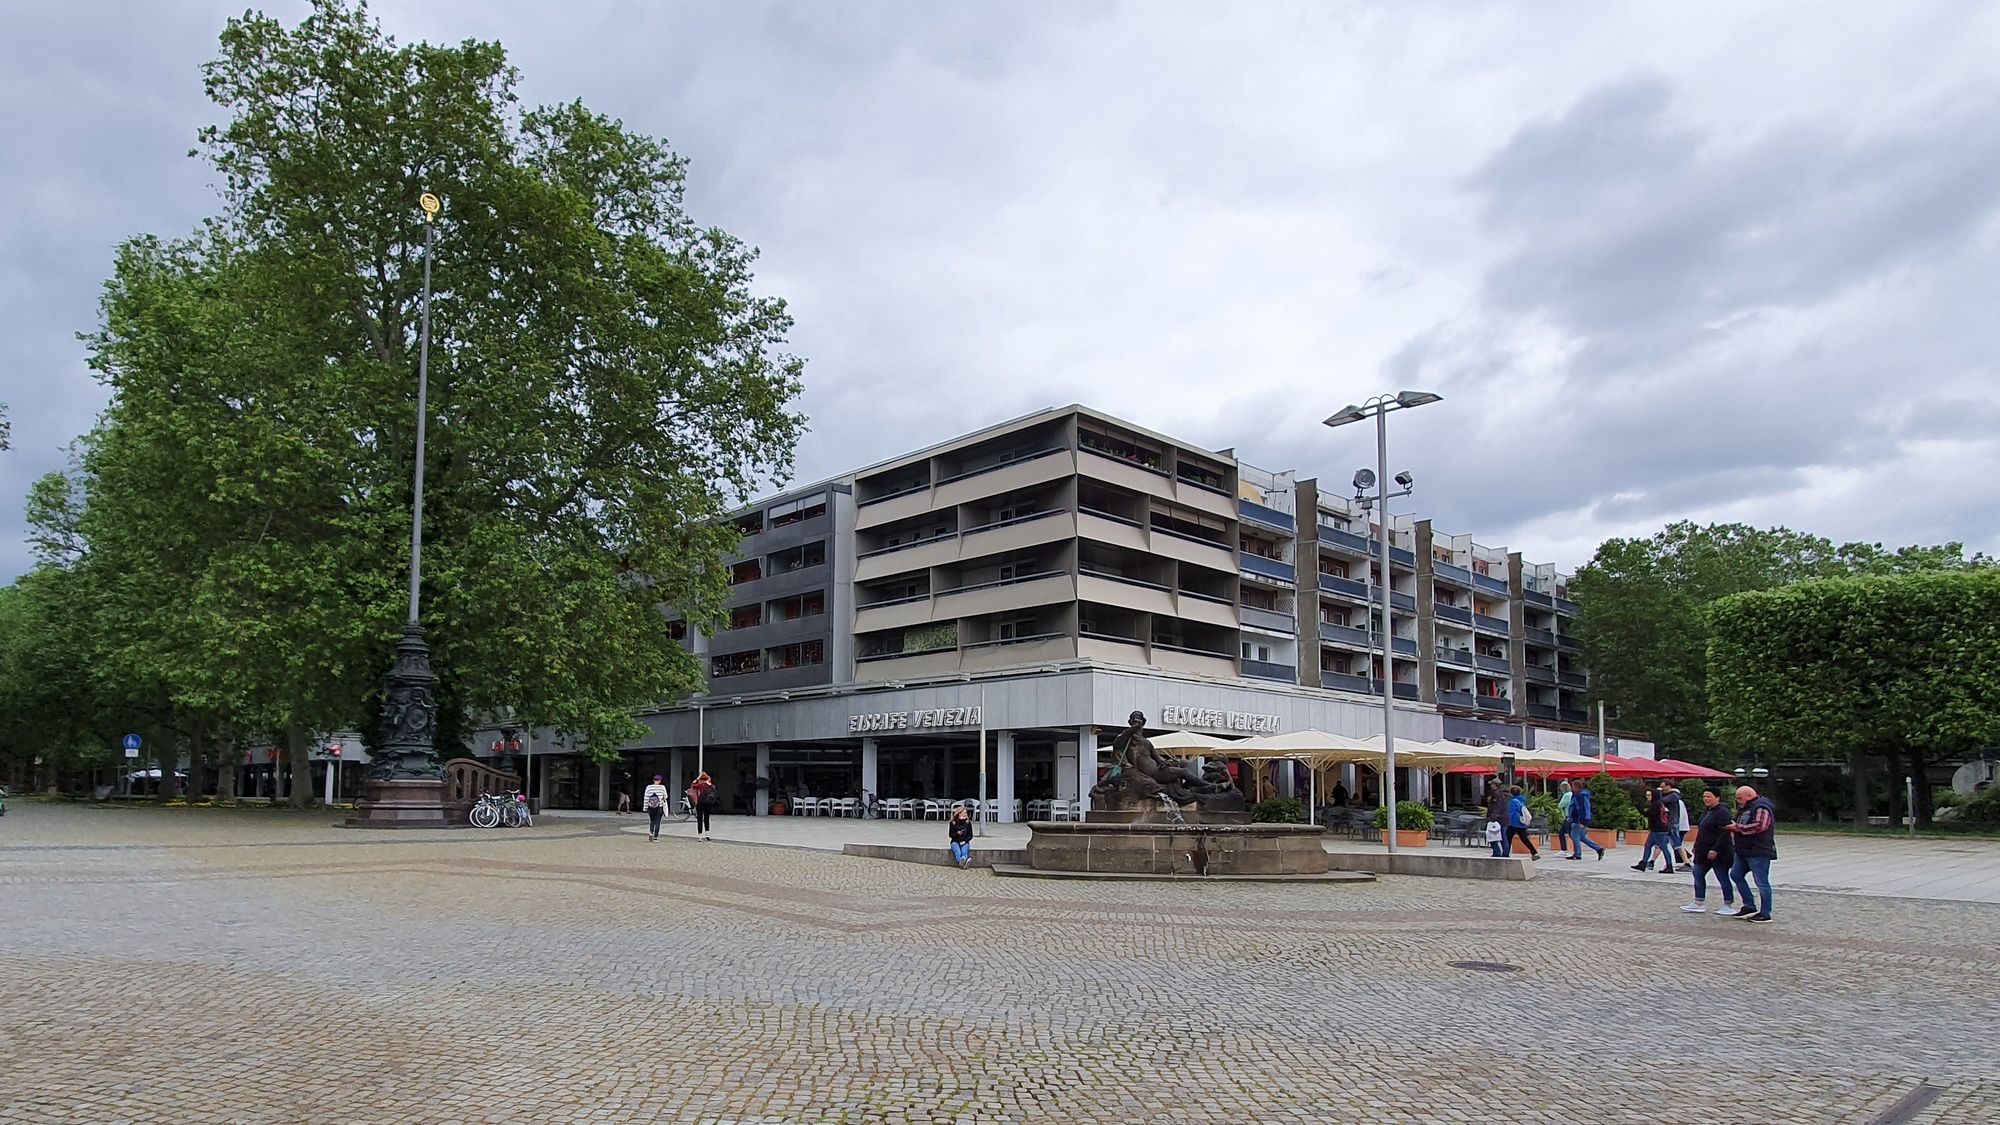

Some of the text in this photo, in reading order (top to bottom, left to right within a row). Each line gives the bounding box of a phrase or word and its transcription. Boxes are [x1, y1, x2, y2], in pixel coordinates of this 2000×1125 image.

[849, 705, 982, 732] EISCAFE VENEZIA
[1164, 704, 1280, 732] EISCAFE VENEZIA
